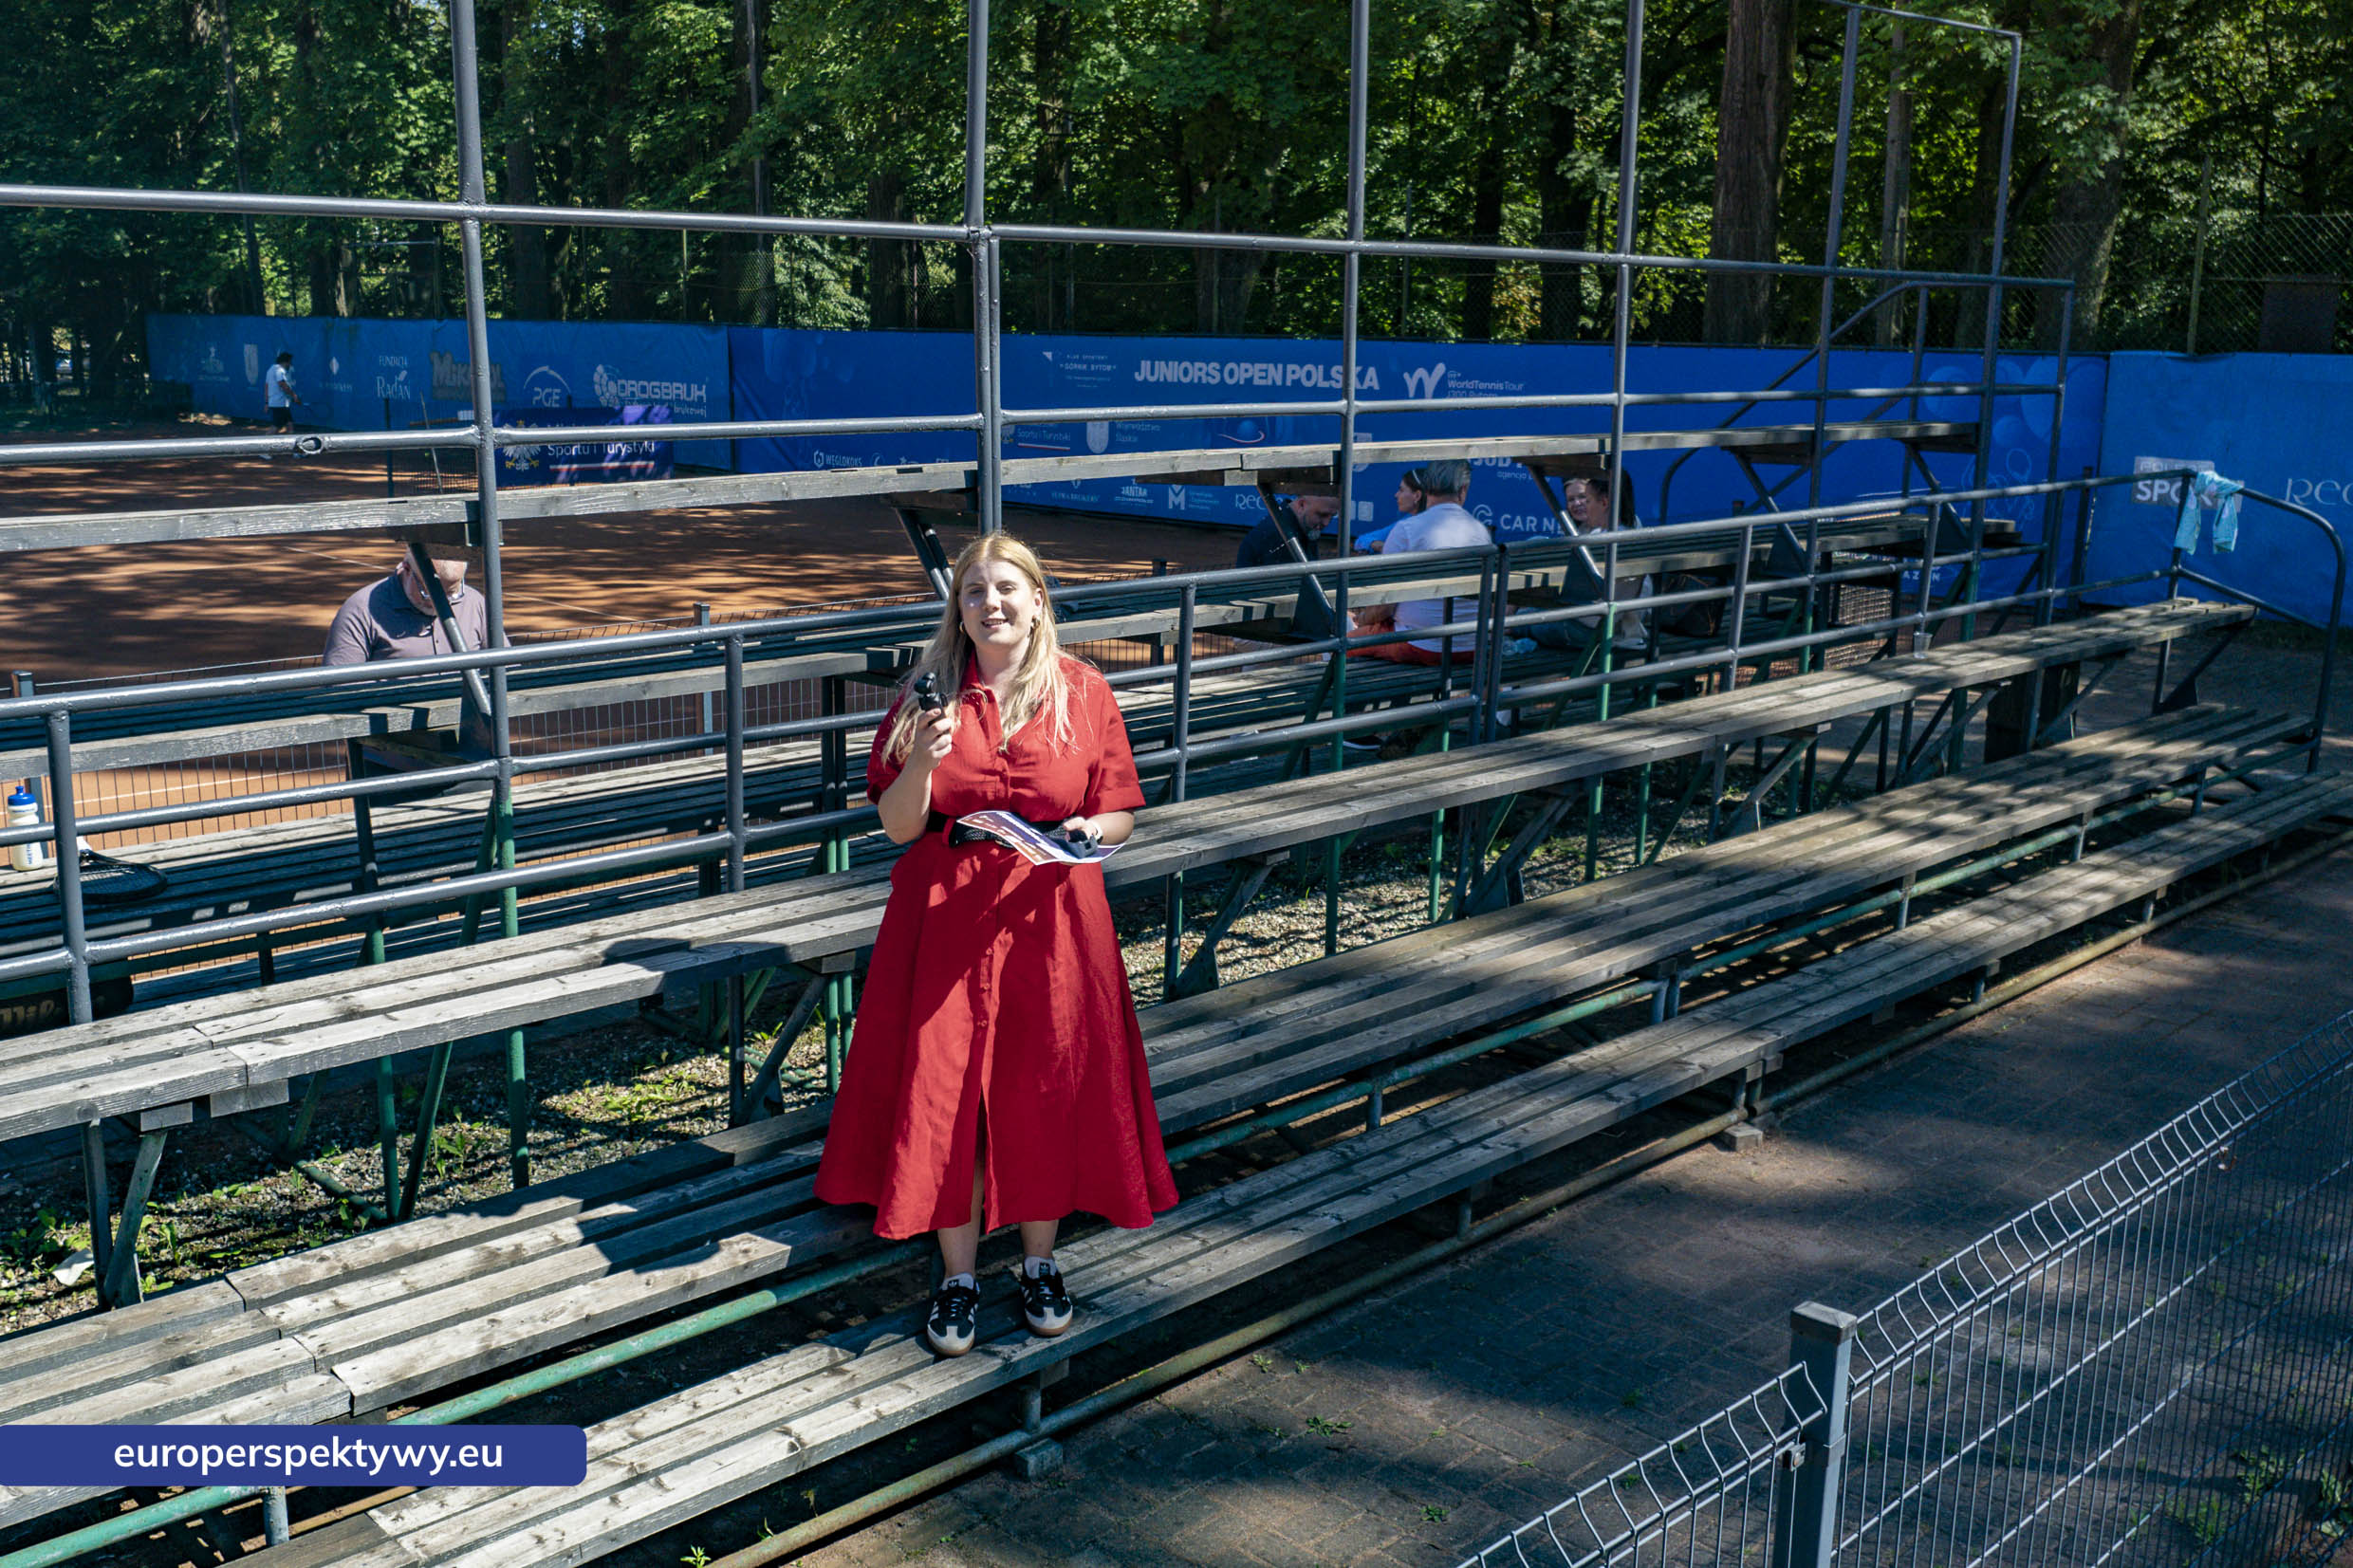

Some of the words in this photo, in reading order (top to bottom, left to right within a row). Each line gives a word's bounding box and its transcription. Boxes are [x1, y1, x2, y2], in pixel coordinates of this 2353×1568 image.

[1135, 360, 1221, 385] JUNIORS
[1223, 361, 1282, 386] OPEN
[532, 387, 562, 407] PGE
[618, 379, 707, 402] DROGBRUK
[547, 443, 589, 457] Sportu
[602, 441, 655, 455] Turystyki
[1500, 514, 1538, 532] CAR
